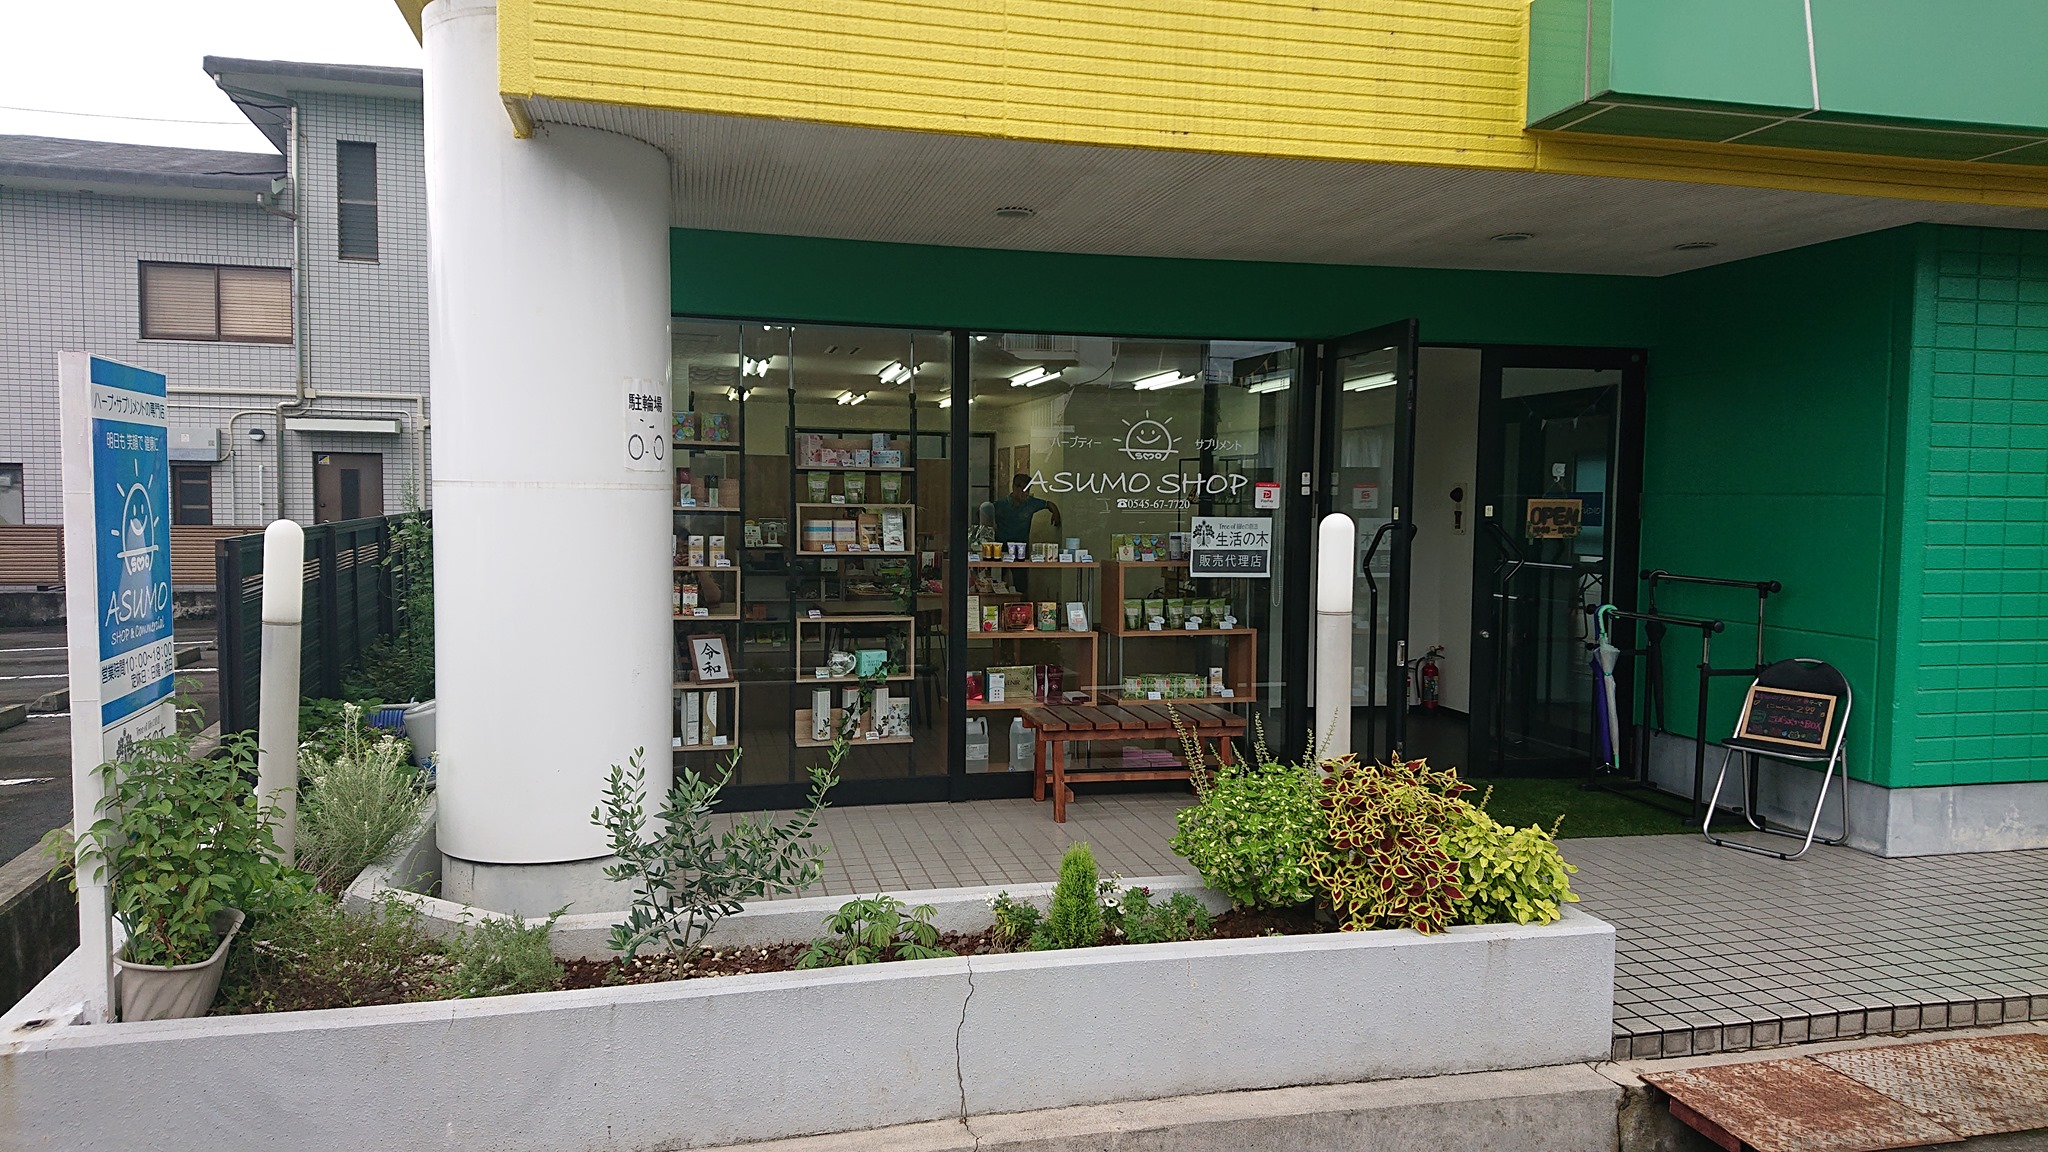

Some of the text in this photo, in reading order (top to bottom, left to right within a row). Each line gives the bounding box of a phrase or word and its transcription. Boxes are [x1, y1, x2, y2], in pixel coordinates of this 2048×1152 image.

[628, 393, 663, 413] 駐輪場
[106, 431, 126, 450] 明日も
[1050, 436, 1102, 449] ハーブティー
[1194, 438, 1242, 451] サプリメント
[1022, 469, 1249, 497] ASUMO SHOP
[1127, 499, 1191, 509] 0545-67-7720
[1530, 506, 1580, 527] OPEN
[1215, 531, 1269, 547] 生活の木
[1199, 554, 1262, 568] 販売代理店
[105, 581, 168, 628] ASUMO
[111, 628, 130, 645] SHOP
[700, 642, 722, 678] 令和
